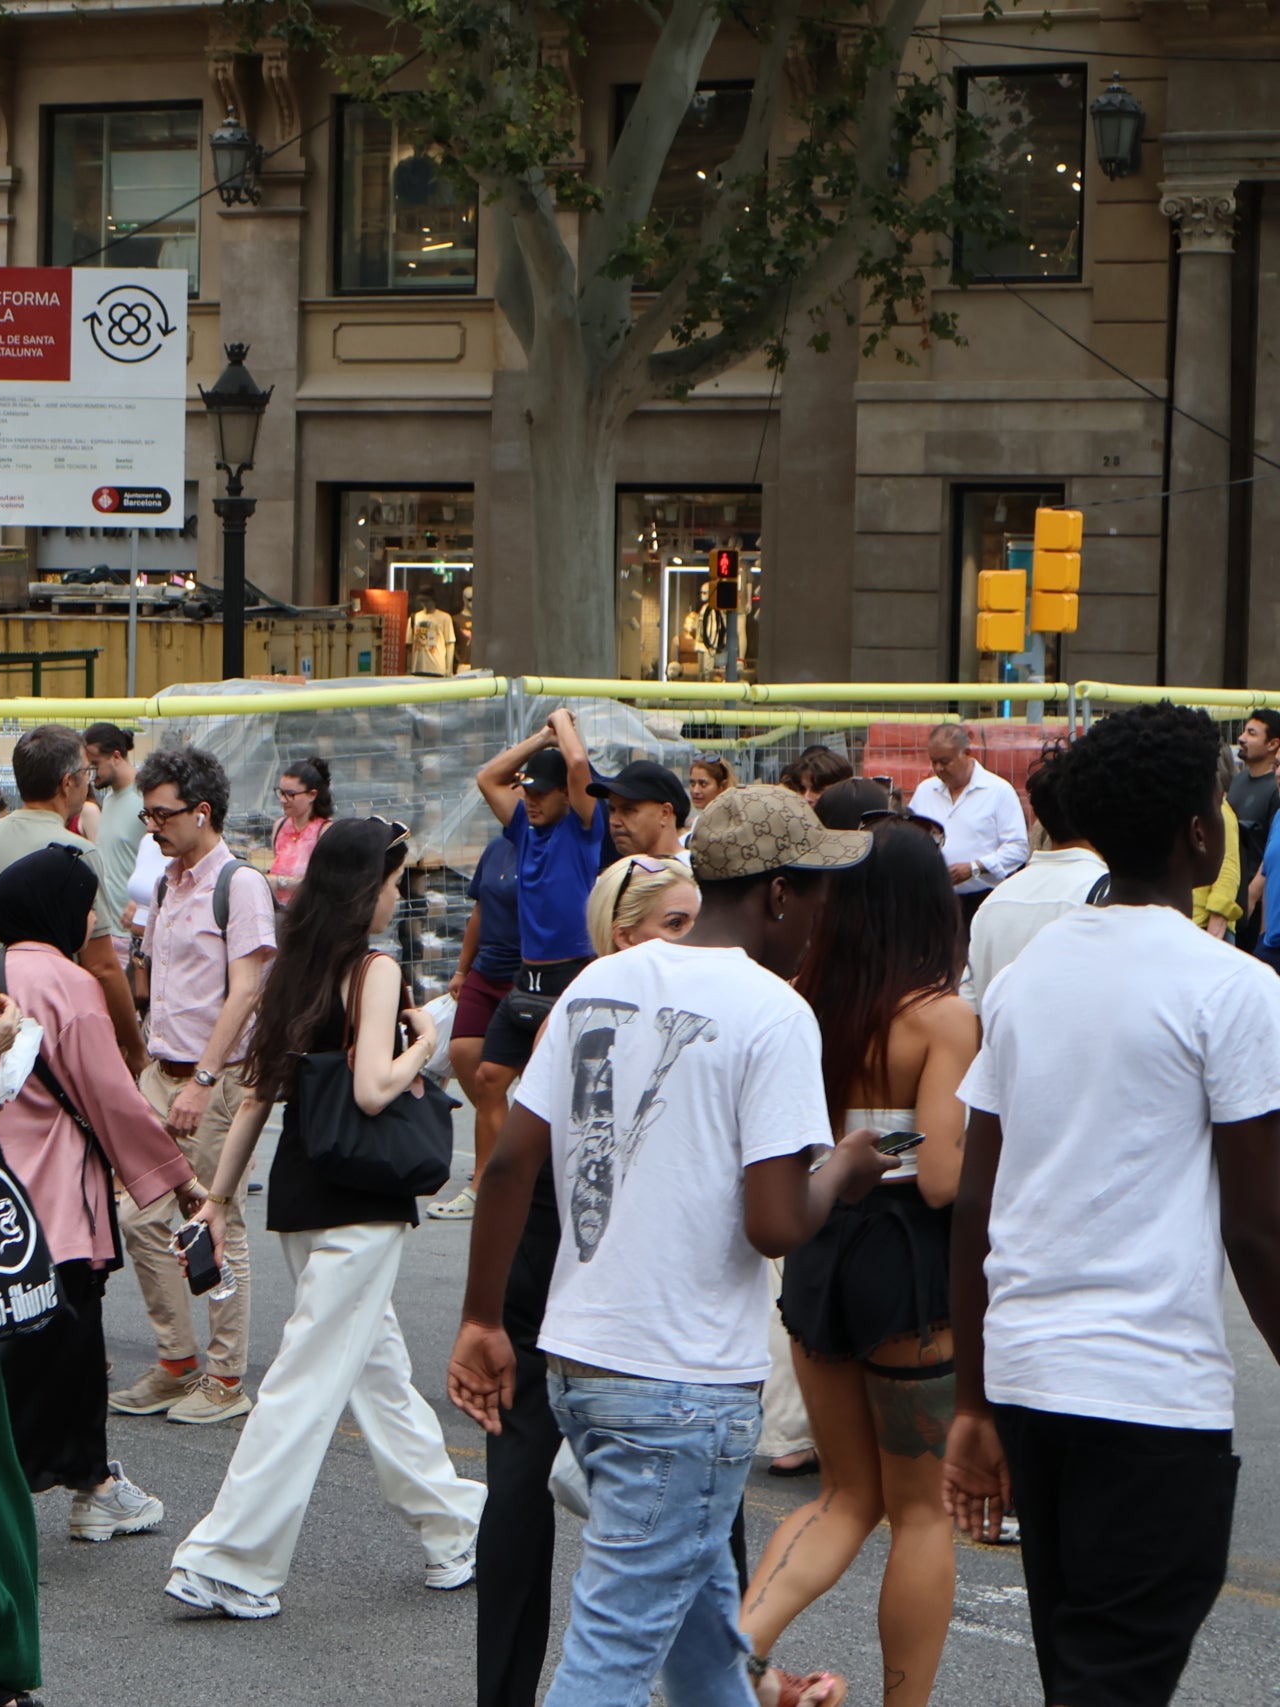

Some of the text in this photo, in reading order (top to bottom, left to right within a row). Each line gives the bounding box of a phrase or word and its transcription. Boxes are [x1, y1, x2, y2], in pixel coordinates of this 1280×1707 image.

[7, 335, 20, 345] DE
[23, 335, 55, 346] SANTA
[123, 498, 162, 507] Barcelona
